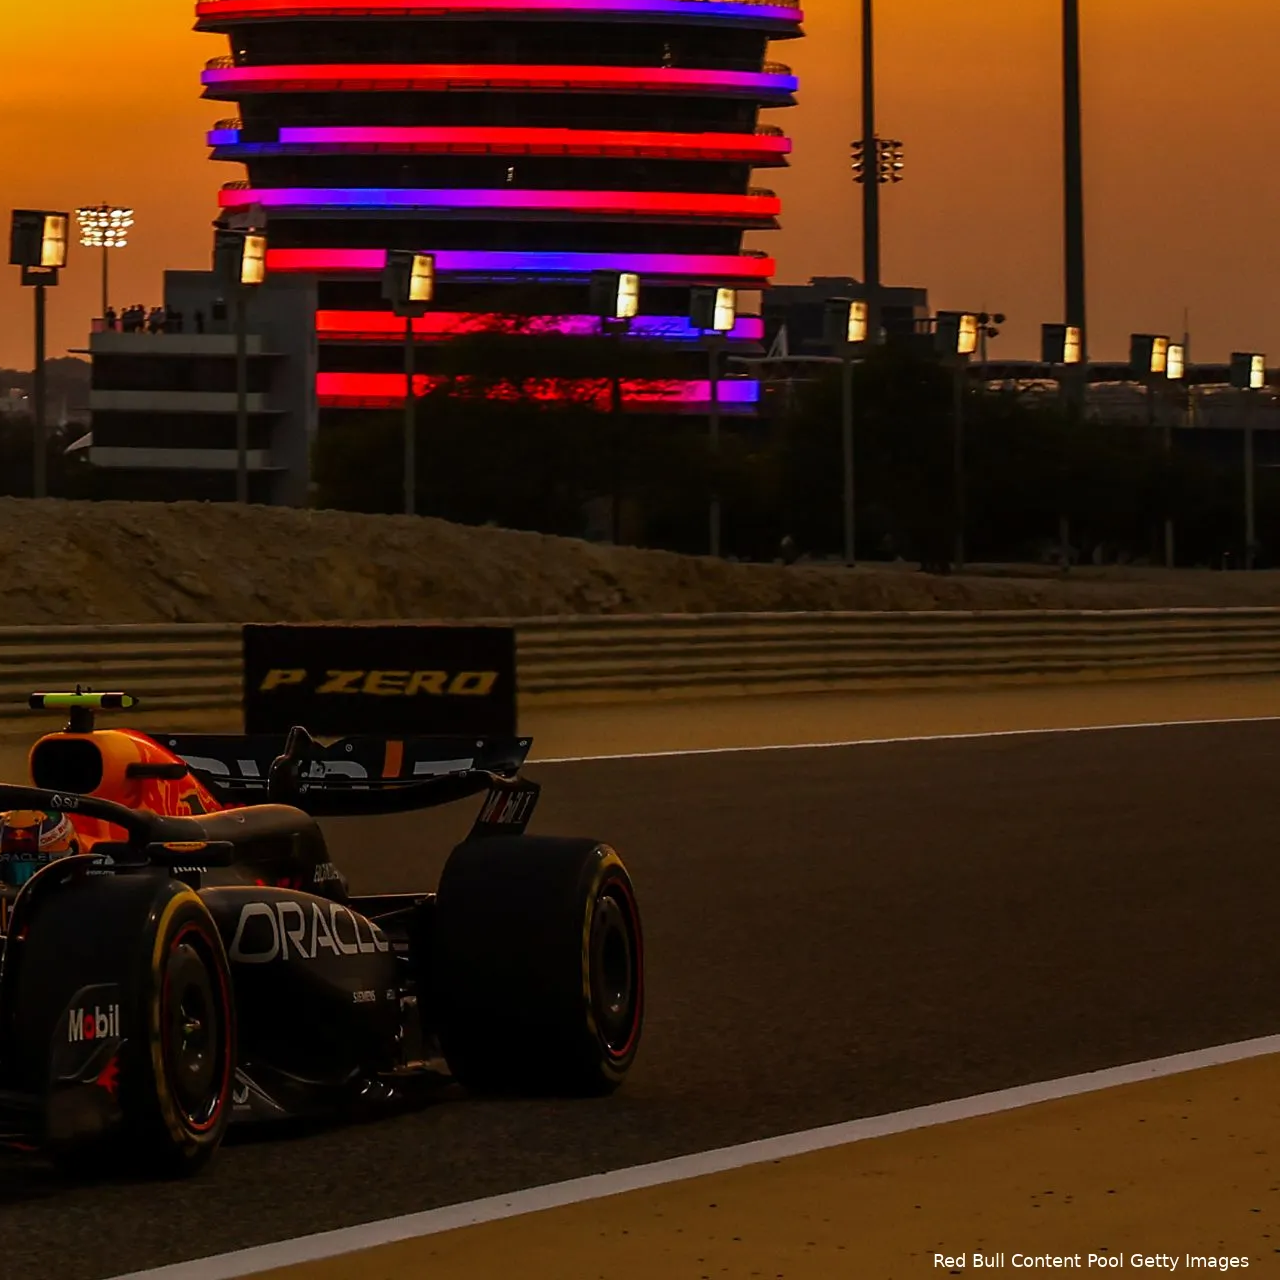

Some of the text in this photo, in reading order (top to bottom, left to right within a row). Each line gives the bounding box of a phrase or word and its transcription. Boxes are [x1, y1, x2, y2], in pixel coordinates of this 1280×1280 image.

[258, 668, 500, 697] P ZERO
[229, 900, 390, 964] ORACLE
[68, 1003, 120, 1043] Mobil
